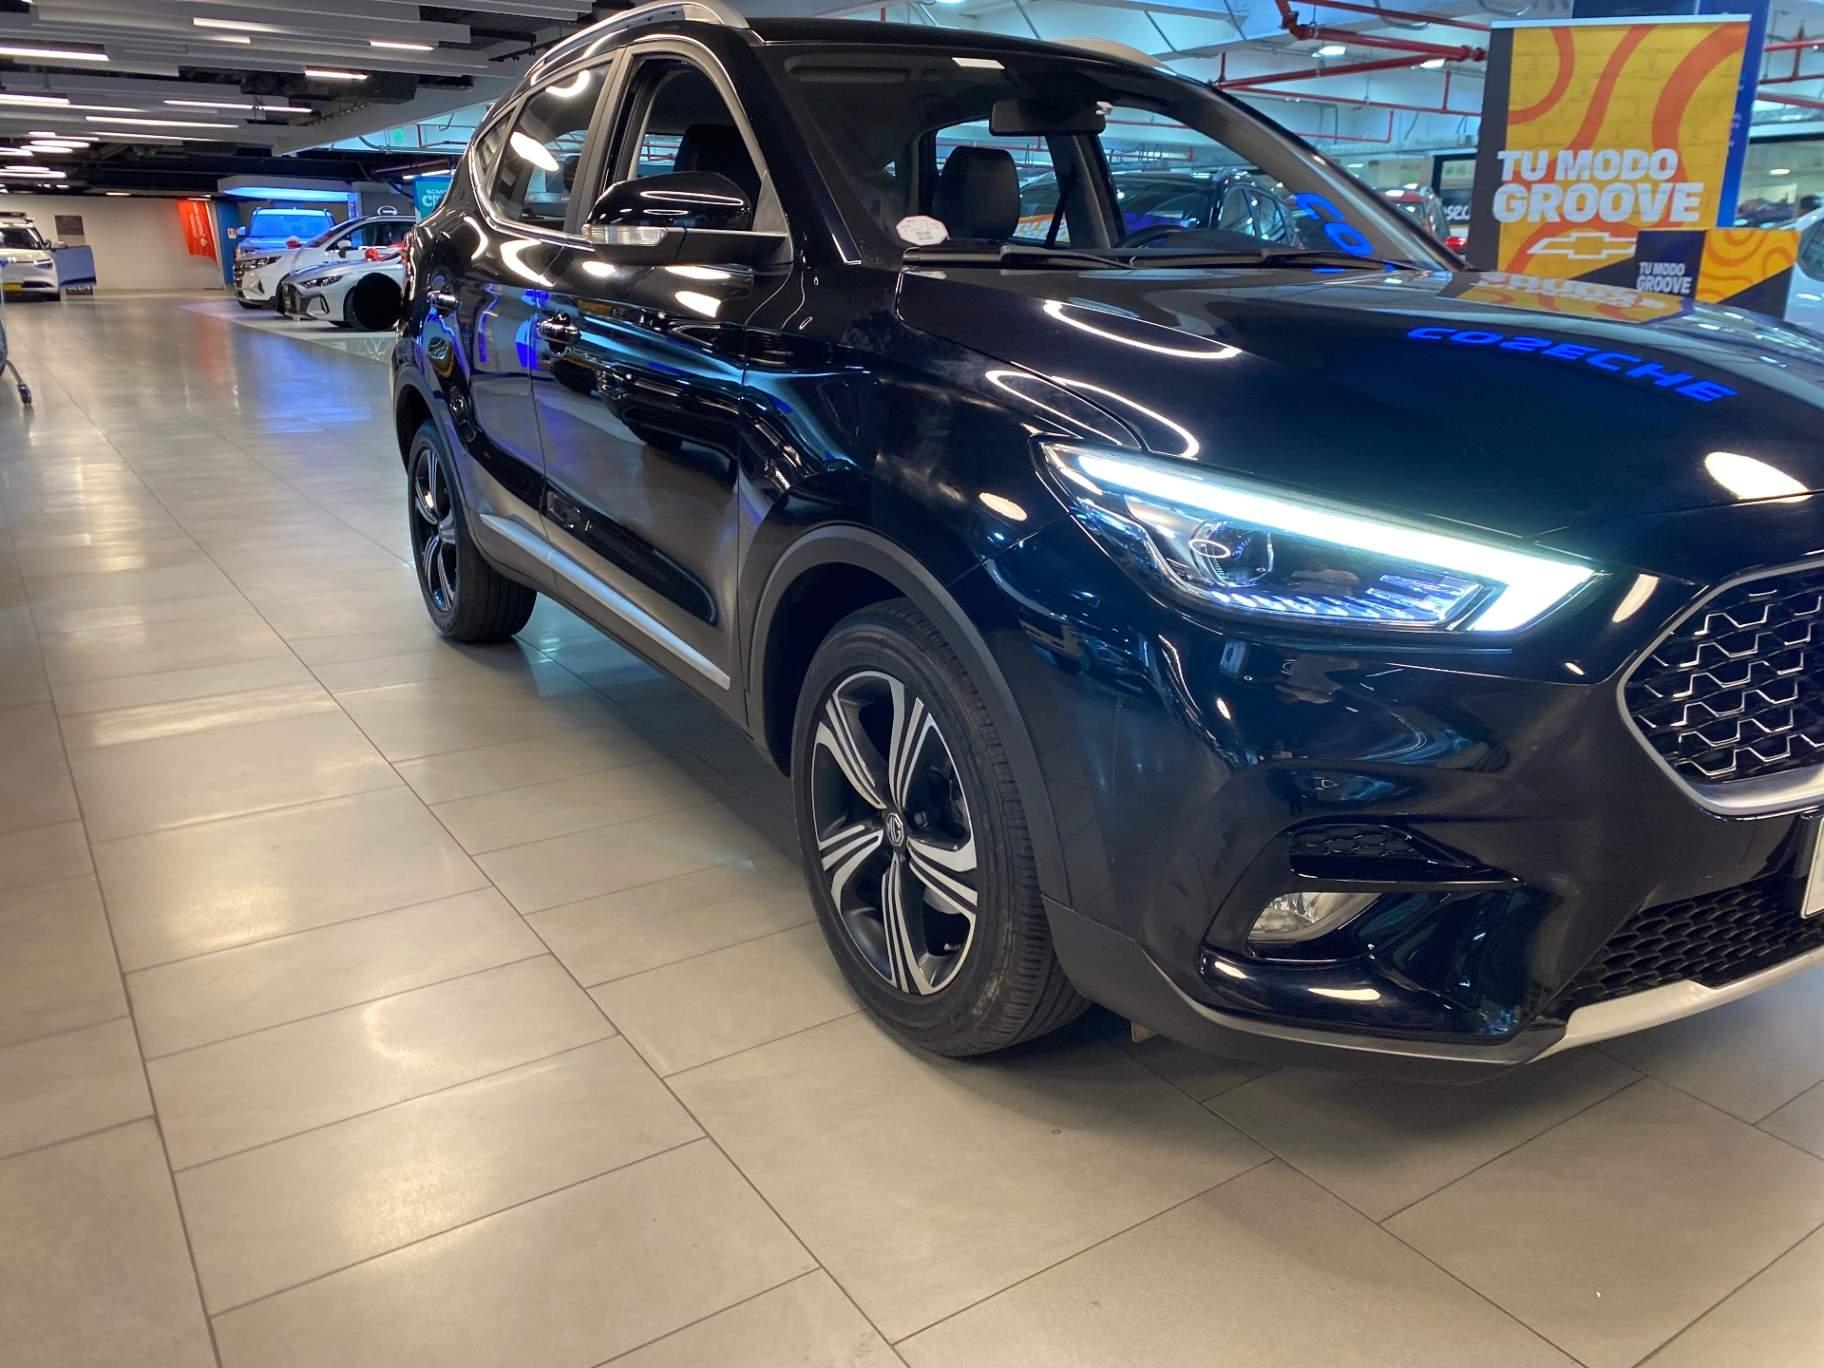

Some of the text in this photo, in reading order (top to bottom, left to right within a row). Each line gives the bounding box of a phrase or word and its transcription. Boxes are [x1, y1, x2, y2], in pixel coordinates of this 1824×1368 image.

[1497, 148, 1679, 181] TU MODO
[1492, 182, 1704, 224] GROOVE
[1639, 262, 1686, 276] TU MODO
[1636, 276, 1693, 294] GROOVE
